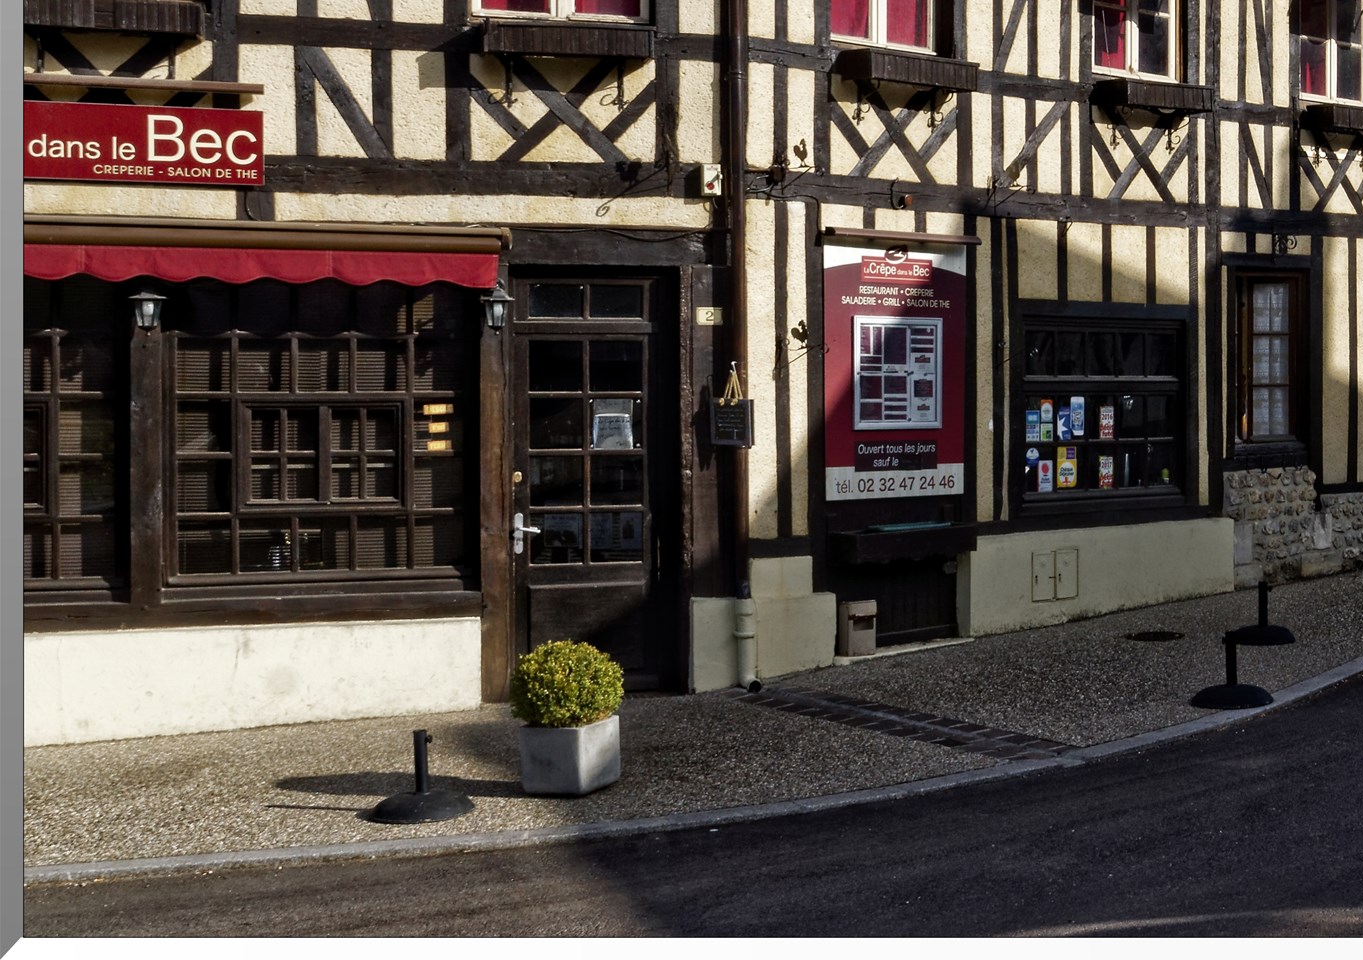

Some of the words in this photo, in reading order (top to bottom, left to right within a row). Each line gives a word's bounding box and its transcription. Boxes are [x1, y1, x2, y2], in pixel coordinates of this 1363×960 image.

[28, 134, 101, 159] dans
[112, 136, 136, 160] le
[147, 114, 257, 165] Bec
[93, 164, 154, 176] CREPERIE
[168, 167, 211, 177] SALON
[216, 168, 232, 178] DE
[236, 169, 257, 179] THE
[863, 266, 869, 274] La
[869, 262, 897, 277] Crêpe
[913, 265, 930, 277] Bec
[859, 285, 899, 296] RESTAURANT
[905, 287, 934, 297] CREPERIE
[841, 295, 876, 305] SALADERIE
[882, 297, 901, 307] GRILL
[906, 298, 929, 308] SALON
[929, 299, 939, 308] DE
[939, 300, 950, 309] THE
[706, 311, 714, 321] 2
[857, 444, 884, 455] Ouvert
[886, 444, 903, 454] tous
[904, 443, 915, 453] les
[915, 442, 936, 455] jours
[873, 456, 890, 467] sauf
[891, 456, 899, 466] le
[836, 480, 854, 494] tél.
[857, 479, 875, 493] 02
[879, 477, 895, 492] 32
[900, 476, 915, 490] 47
[920, 476, 935, 490] 24
[939, 475, 955, 489] 46
